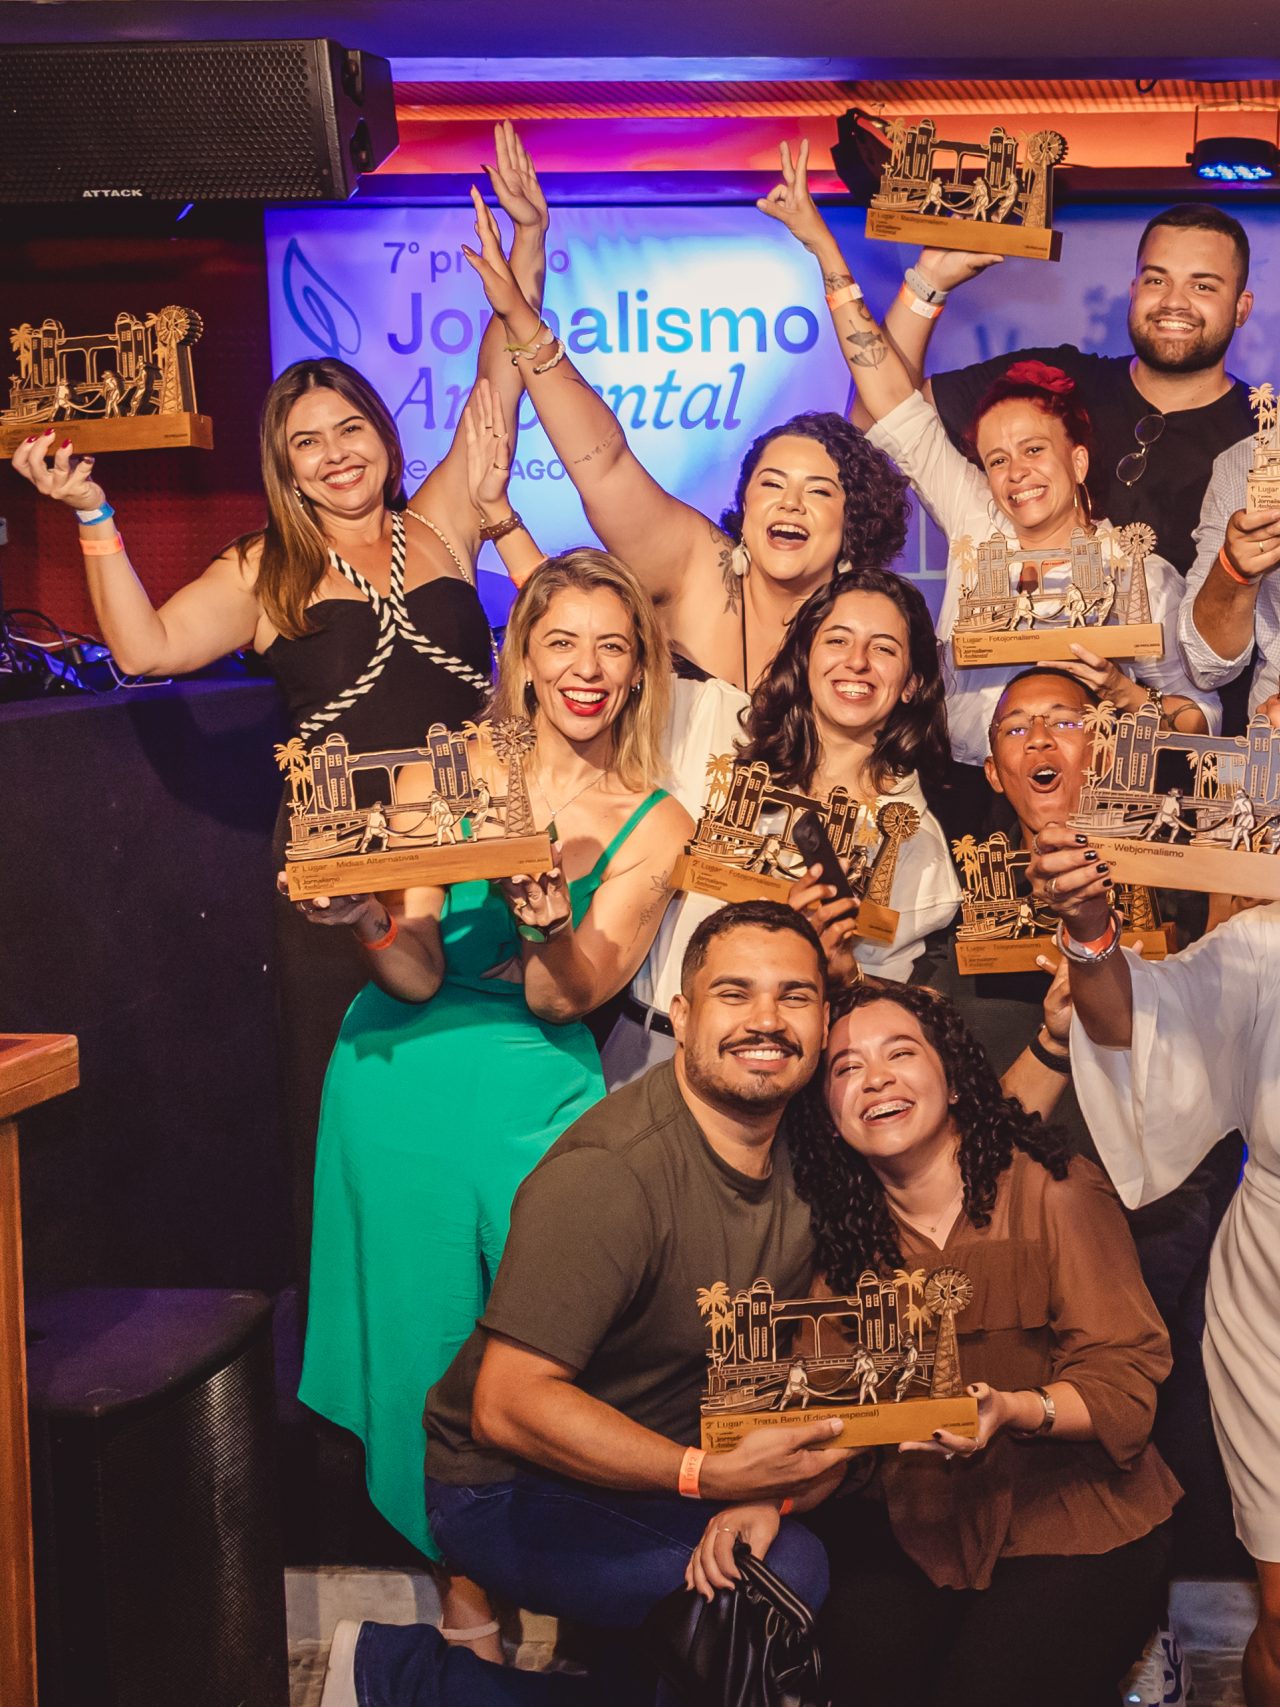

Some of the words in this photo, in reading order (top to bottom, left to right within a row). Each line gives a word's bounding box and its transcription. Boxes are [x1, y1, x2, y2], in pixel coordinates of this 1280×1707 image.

[82, 189, 143, 197] ATTACK
[387, 289, 820, 355] Joalismo
[1258, 486, 1280, 494] Lugar
[989, 634, 1040, 643] Fotojornalismo
[1114, 843, 1185, 858] Webjornalismo
[302, 863, 328, 873] Lugar
[366, 854, 420, 865] Alternativas
[717, 1420, 744, 1430] Lugar
[753, 1416, 778, 1426] Trata
[780, 1414, 801, 1424] Bem
